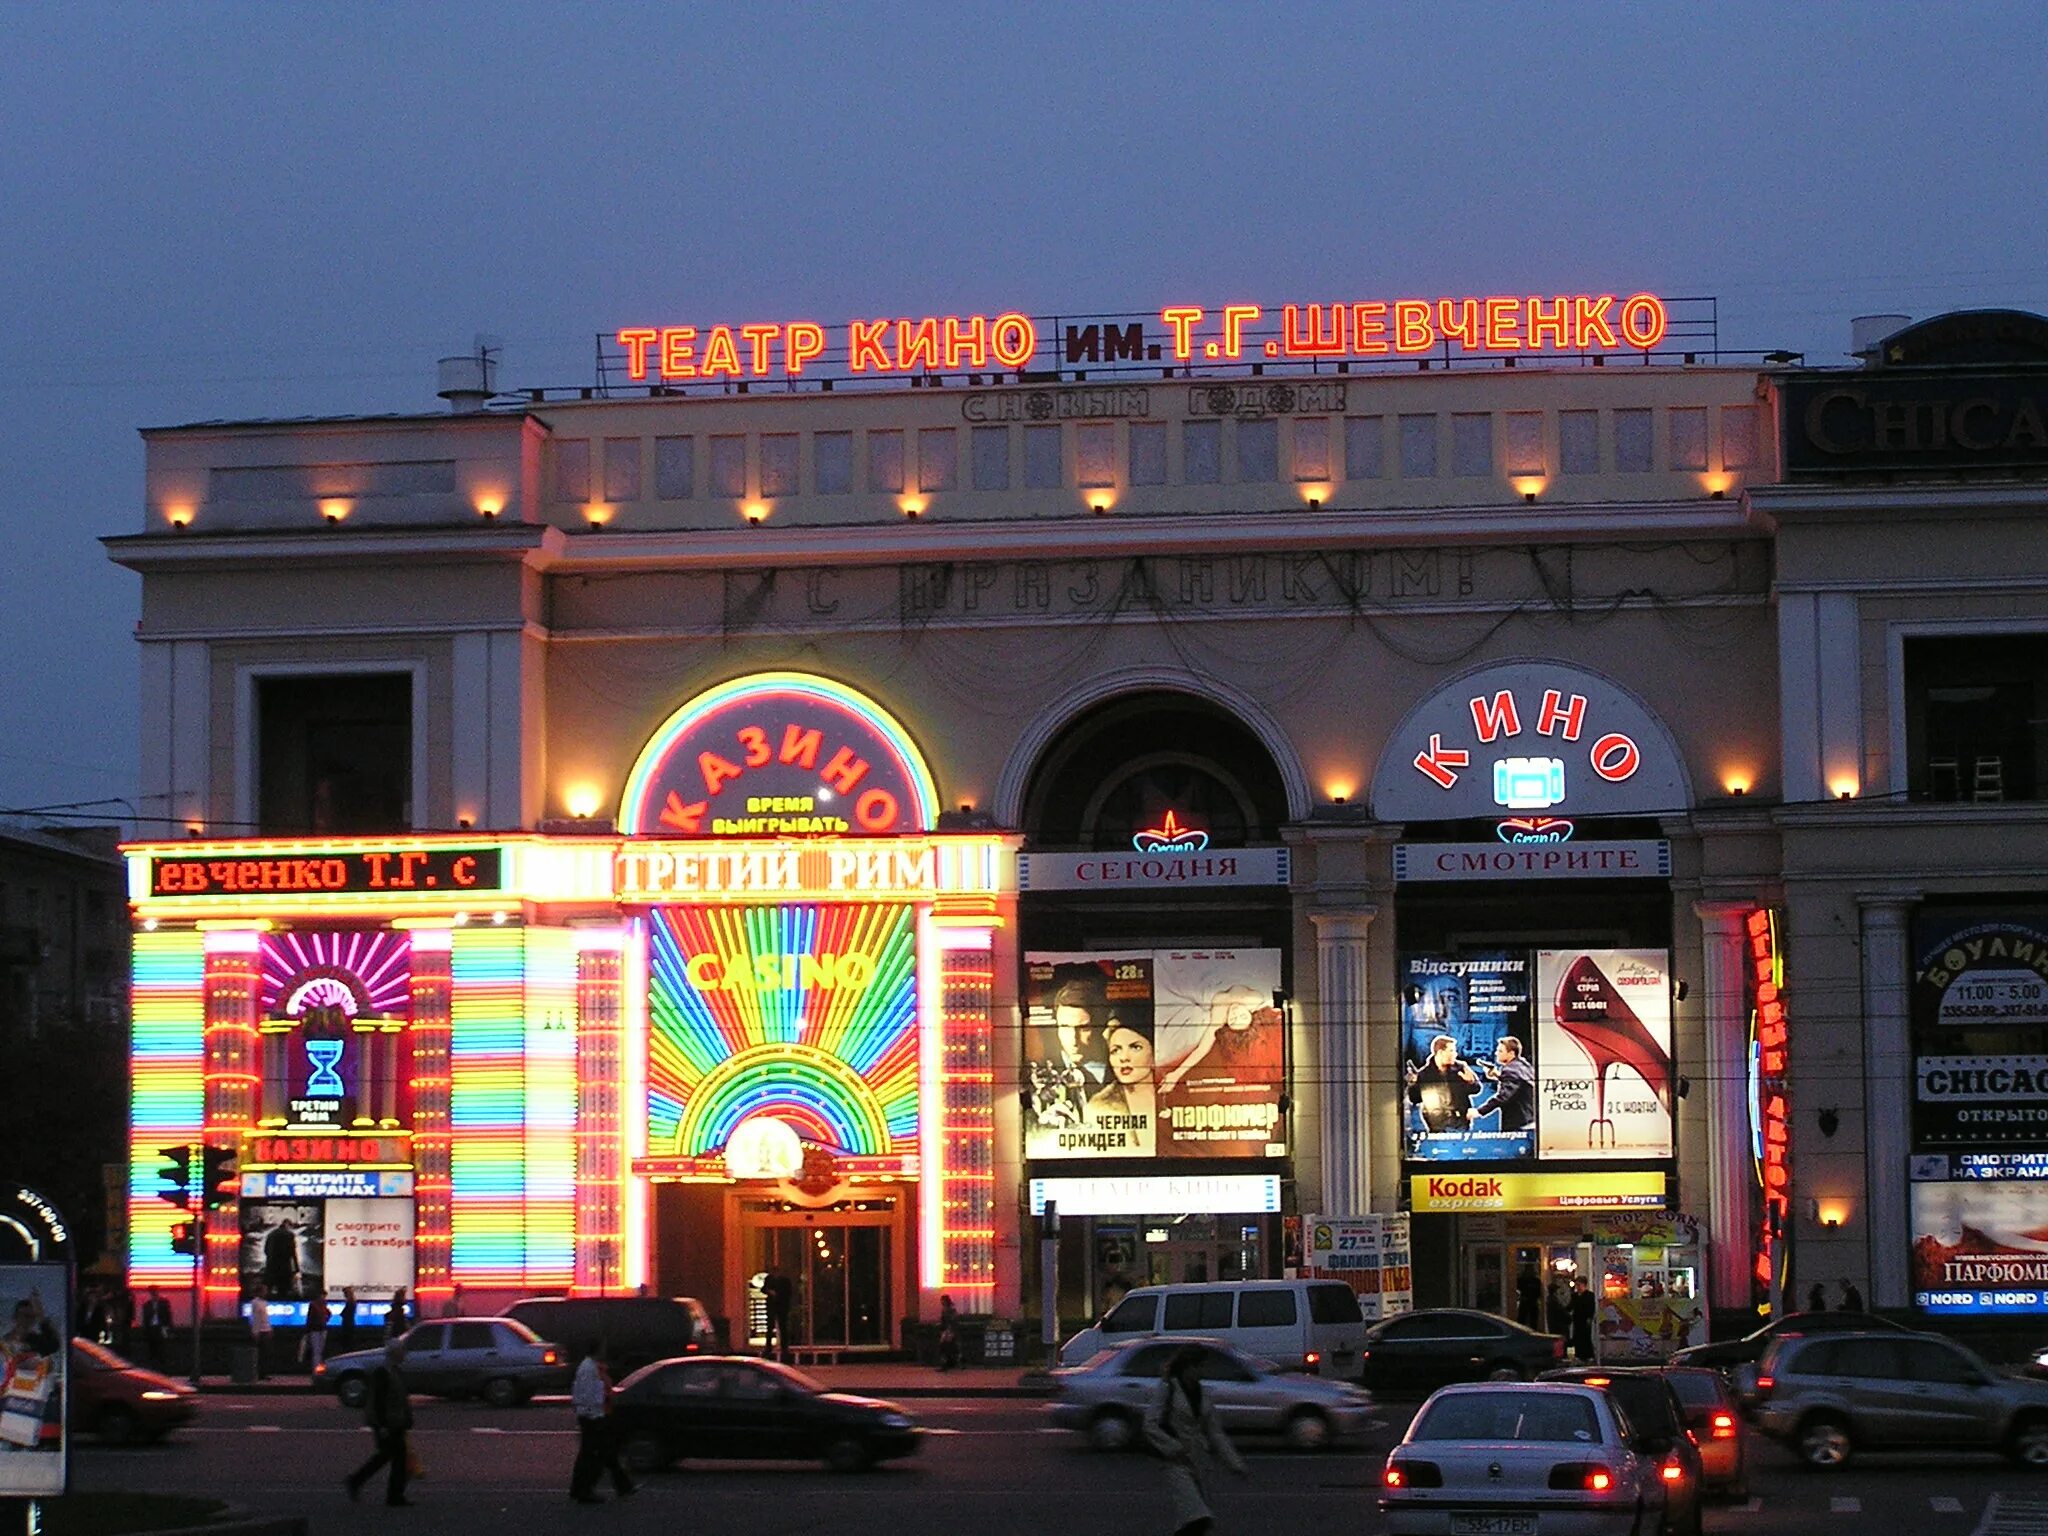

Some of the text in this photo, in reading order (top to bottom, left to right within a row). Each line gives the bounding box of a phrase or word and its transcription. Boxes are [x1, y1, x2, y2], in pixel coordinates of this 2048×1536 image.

[617, 320, 827, 379] ТЕАТР
[850, 312, 1036, 371] КИНО
[1413, 689, 1640, 789] КИНО
[660, 723, 898, 834] КАЗИНО
[747, 796, 814, 814] ВРЕМЯ
[711, 816, 849, 834] ВЫИГРЫВАТЬ
[1075, 857, 1238, 883] СЕГОДНЯ
[1436, 850, 1640, 872] СМОТРИТЕ
[827, 850, 937, 892] РИМ
[686, 952, 876, 991] CASINO
[1550, 1099, 1587, 1110] Prada
[1960, 1153, 2048, 1165] СМОТРИТ
[275, 1173, 366, 1185] СМОТРИТЕ
[1952, 1168, 1978, 1178] НА
[294, 1184, 377, 1196] ЭКРАНАХ
[1428, 1177, 1503, 1198] Kodak
[1428, 1196, 1505, 1209] express
[1559, 1194, 1658, 1207] Цифровые Услуги
[343, 1236, 358, 1246] 12
[1931, 1292, 2038, 1305] NORD NORD
